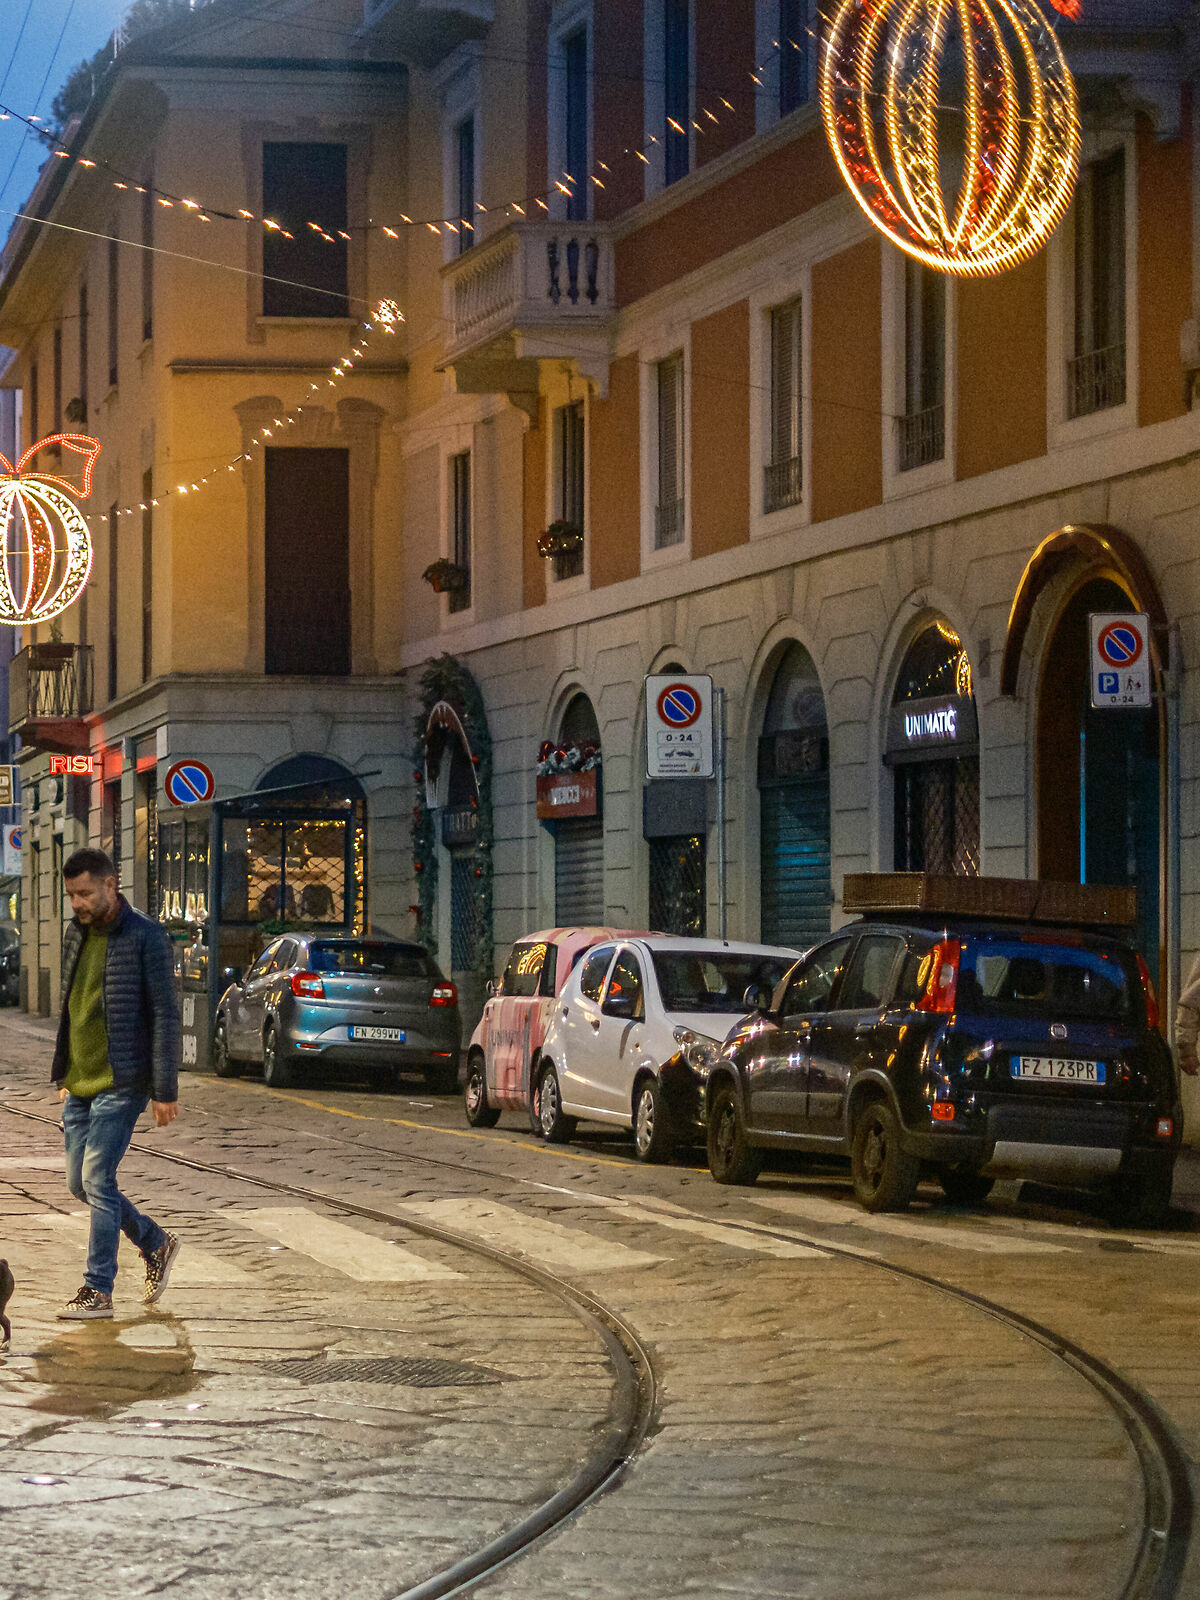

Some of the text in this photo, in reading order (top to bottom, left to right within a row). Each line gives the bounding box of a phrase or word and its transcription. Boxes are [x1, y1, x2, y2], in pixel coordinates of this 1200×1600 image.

[905, 709, 956, 737] UNIMATIC
[50, 755, 94, 774] RISI
[1022, 1059, 1095, 1079] FZ 123PR
